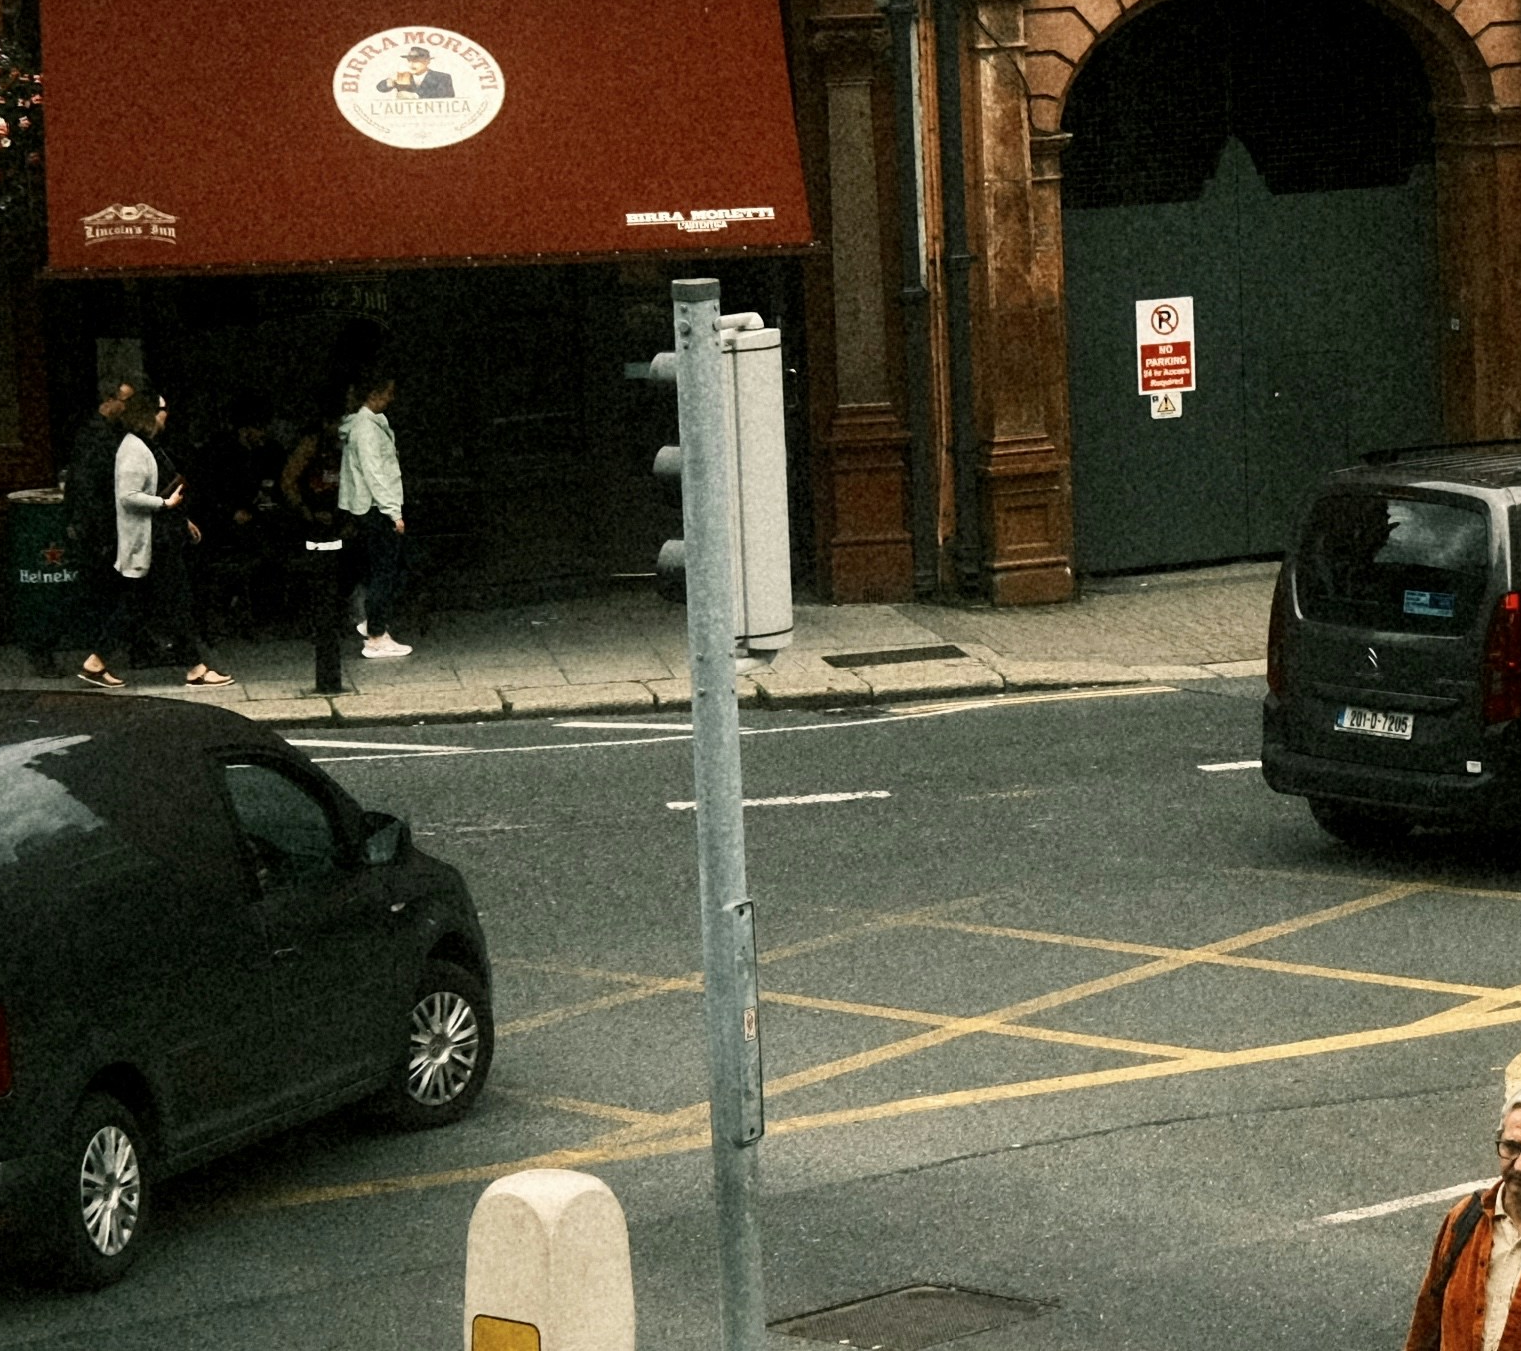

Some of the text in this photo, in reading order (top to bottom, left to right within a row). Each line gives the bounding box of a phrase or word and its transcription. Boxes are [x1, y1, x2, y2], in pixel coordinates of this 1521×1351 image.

[341, 31, 499, 94] BIRRA MORETTI
[370, 99, 471, 116] L'AUTENTICA
[625, 207, 775, 223] BIRRA MORETTI
[83, 223, 177, 240] Lincoln's Inn
[1158, 345, 1173, 354] NO
[1145, 356, 1188, 368] PARKING
[1150, 377, 1184, 388] Required
[1349, 710, 1409, 734] 201-D-7205
